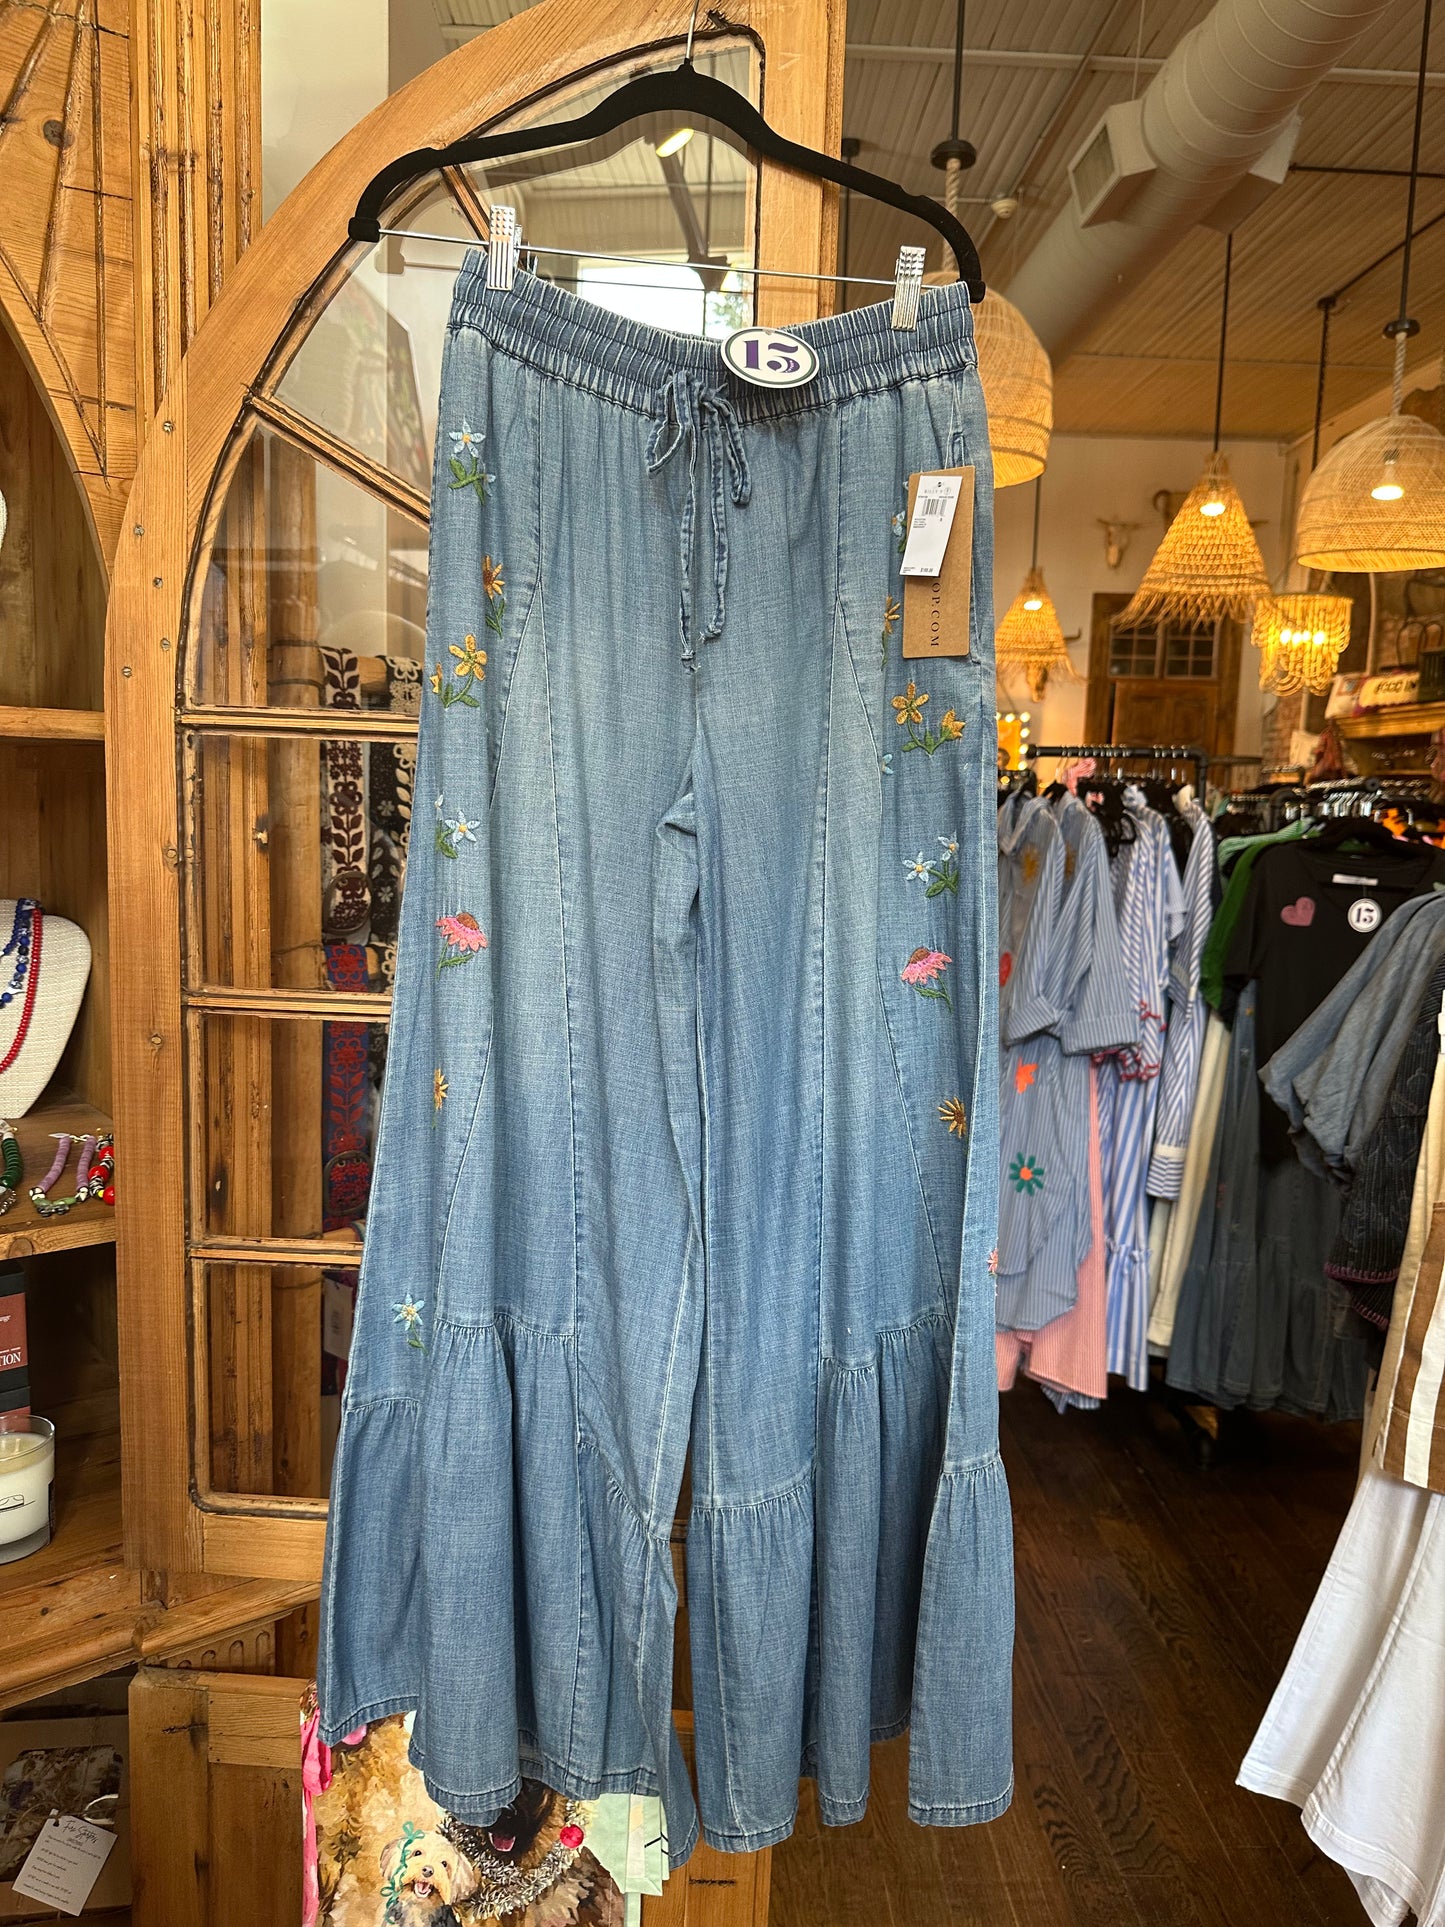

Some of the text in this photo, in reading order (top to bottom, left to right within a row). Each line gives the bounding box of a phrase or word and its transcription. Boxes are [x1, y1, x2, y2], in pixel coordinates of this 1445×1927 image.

[743, 340, 800, 373] 15
[930, 577, 941, 647] OP.COM
[1356, 907, 1375, 924] 15
